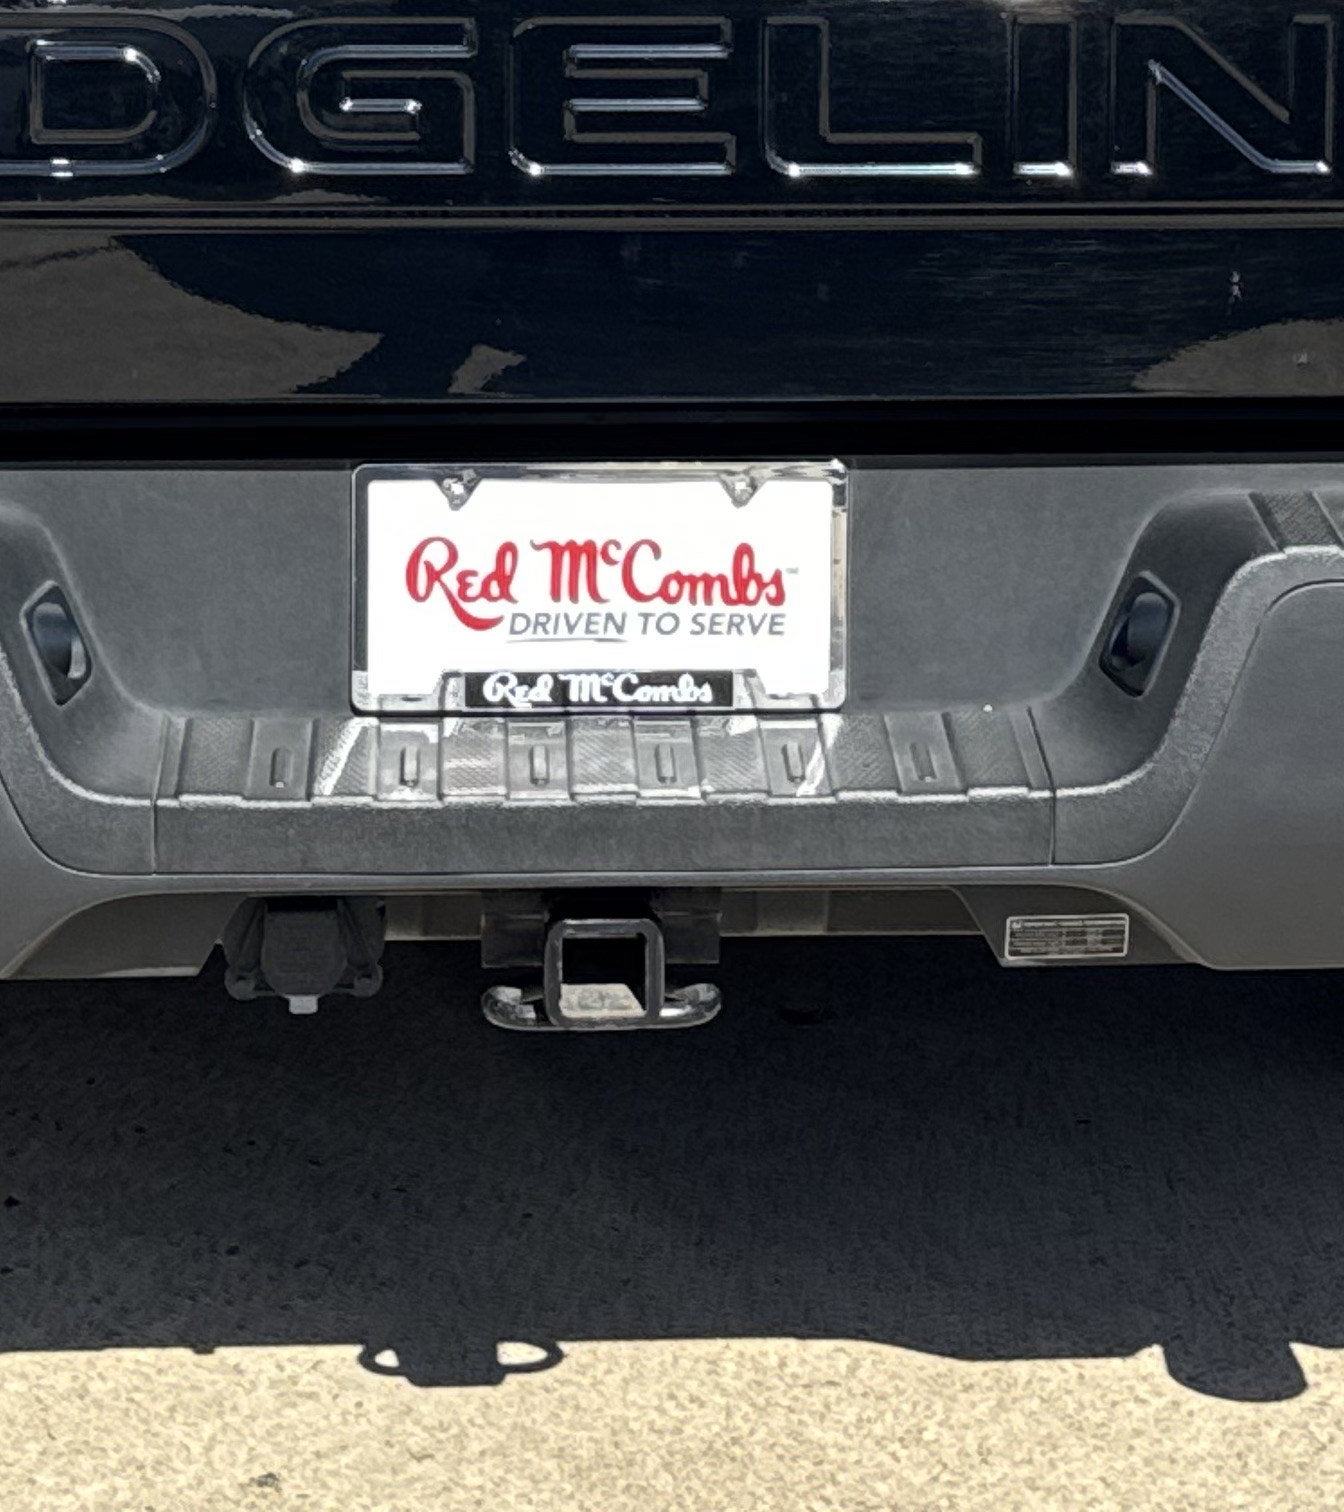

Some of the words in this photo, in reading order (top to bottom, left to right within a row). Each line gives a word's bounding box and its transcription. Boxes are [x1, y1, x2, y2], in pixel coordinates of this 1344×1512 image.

[405, 536, 519, 631] Red
[529, 538, 787, 606] McCombs
[508, 612, 628, 636] DRIVEN
[638, 612, 680, 636] TO
[690, 611, 786, 636] SERVE
[482, 672, 554, 709] Red
[558, 672, 714, 702] McCombs
